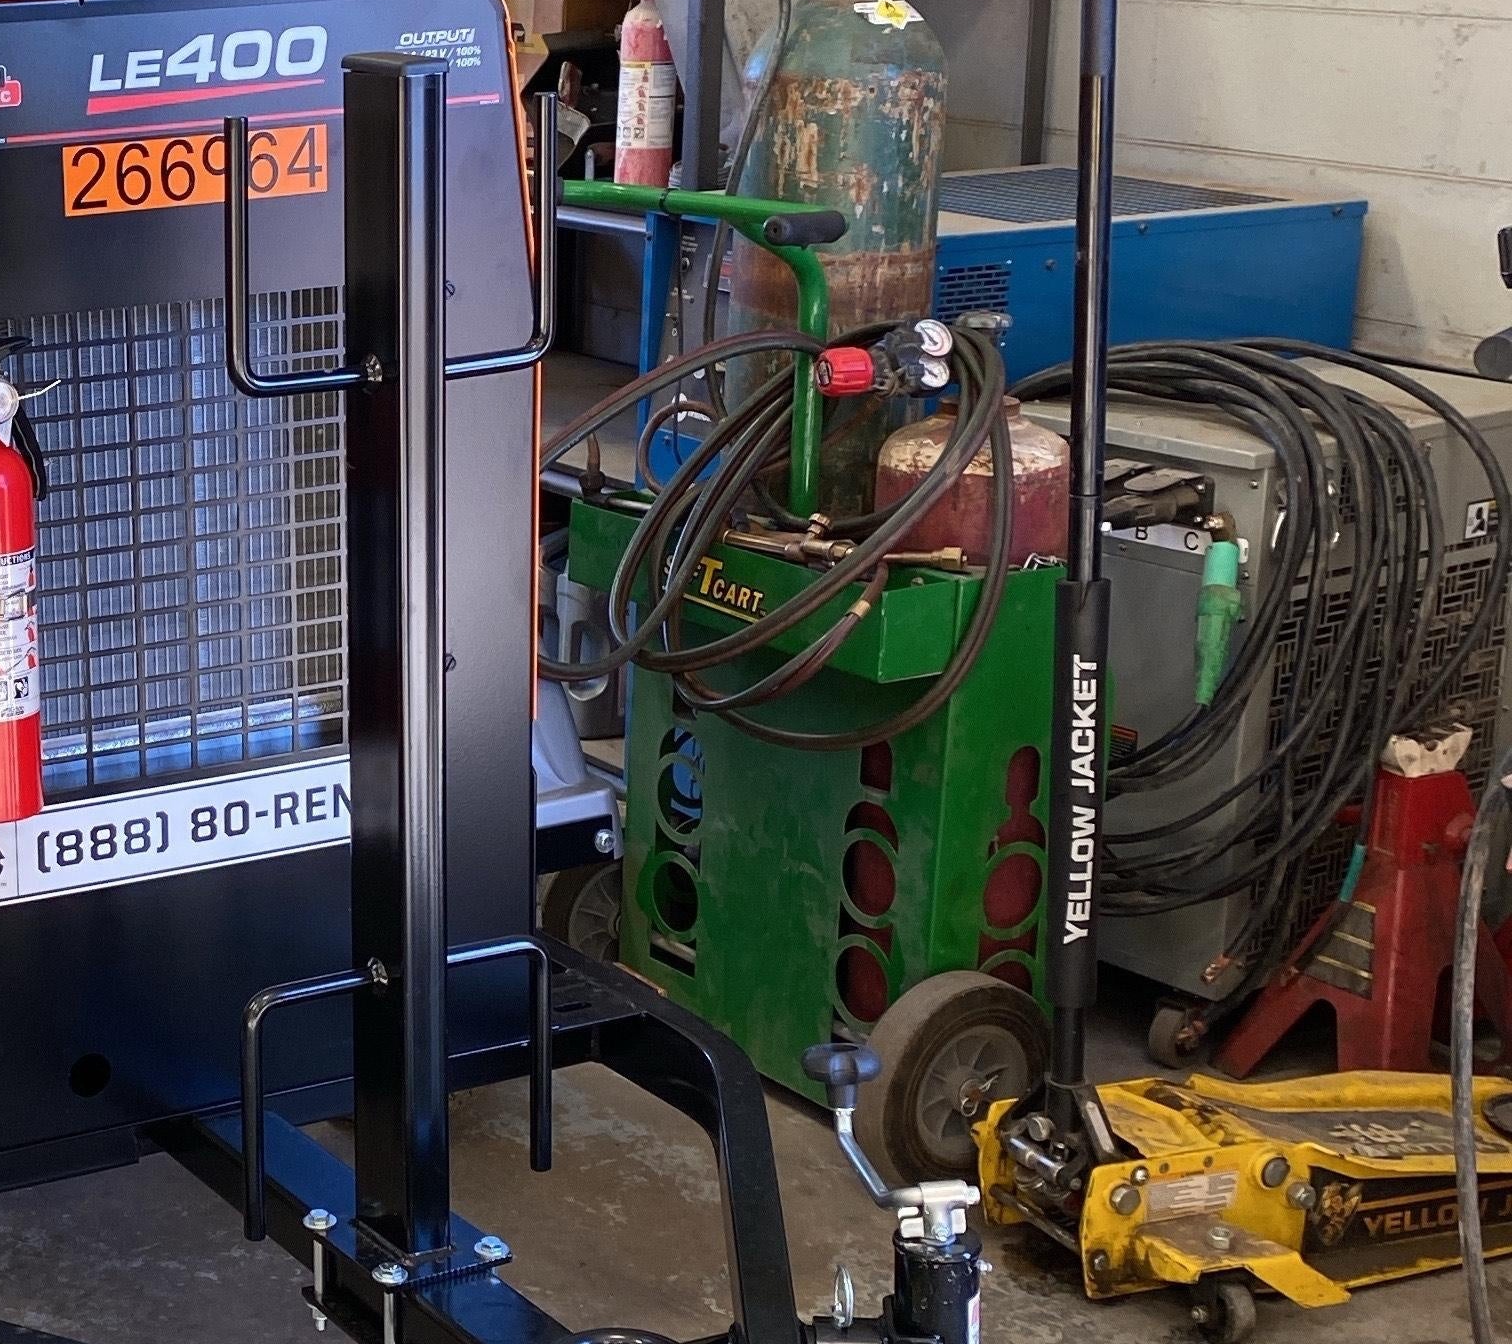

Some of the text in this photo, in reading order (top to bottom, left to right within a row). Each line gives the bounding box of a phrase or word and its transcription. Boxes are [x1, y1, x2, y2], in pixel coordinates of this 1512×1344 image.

[399, 28, 471, 46] OUTPUT
[456, 45, 482, 57] 100%
[89, 25, 328, 92] LE400
[456, 56, 482, 68] 100%
[1062, 654, 1098, 945] YELLOW JACKET
[36, 810, 169, 874] (888)
[1363, 1198, 1488, 1239] YELLO
